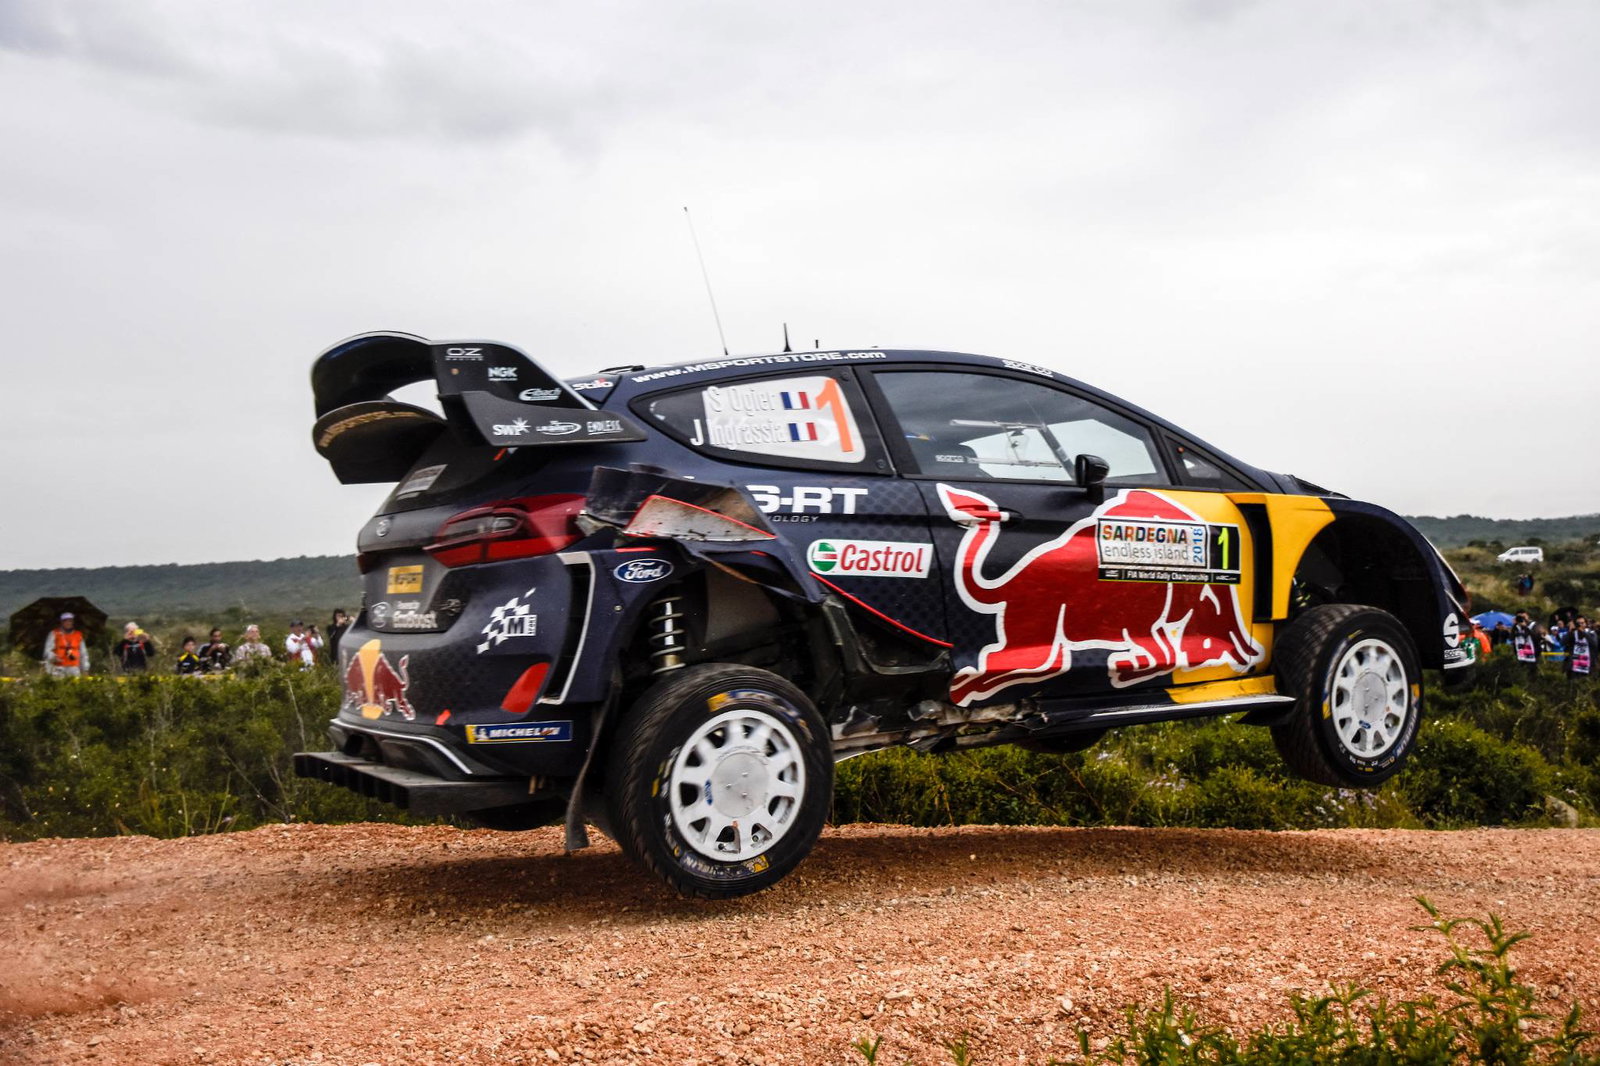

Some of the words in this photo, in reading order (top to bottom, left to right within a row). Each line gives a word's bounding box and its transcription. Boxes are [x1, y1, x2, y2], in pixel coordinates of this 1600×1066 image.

[487, 367, 518, 377] NGK
[632, 351, 886, 383] www.MSPORTSTORE.com
[706, 386, 722, 412] S
[732, 387, 777, 416] Ogier
[815, 378, 854, 452] 1
[690, 418, 704, 446] J
[707, 418, 786, 450] Ingrassia
[1102, 524, 1188, 544] SARDEGNA
[1192, 528, 1204, 563] 2018
[1217, 527, 1229, 569] 1
[840, 544, 924, 573] Castrol
[1104, 544, 1151, 558] endless
[1154, 546, 1189, 560] island
[626, 561, 662, 580] Ford
